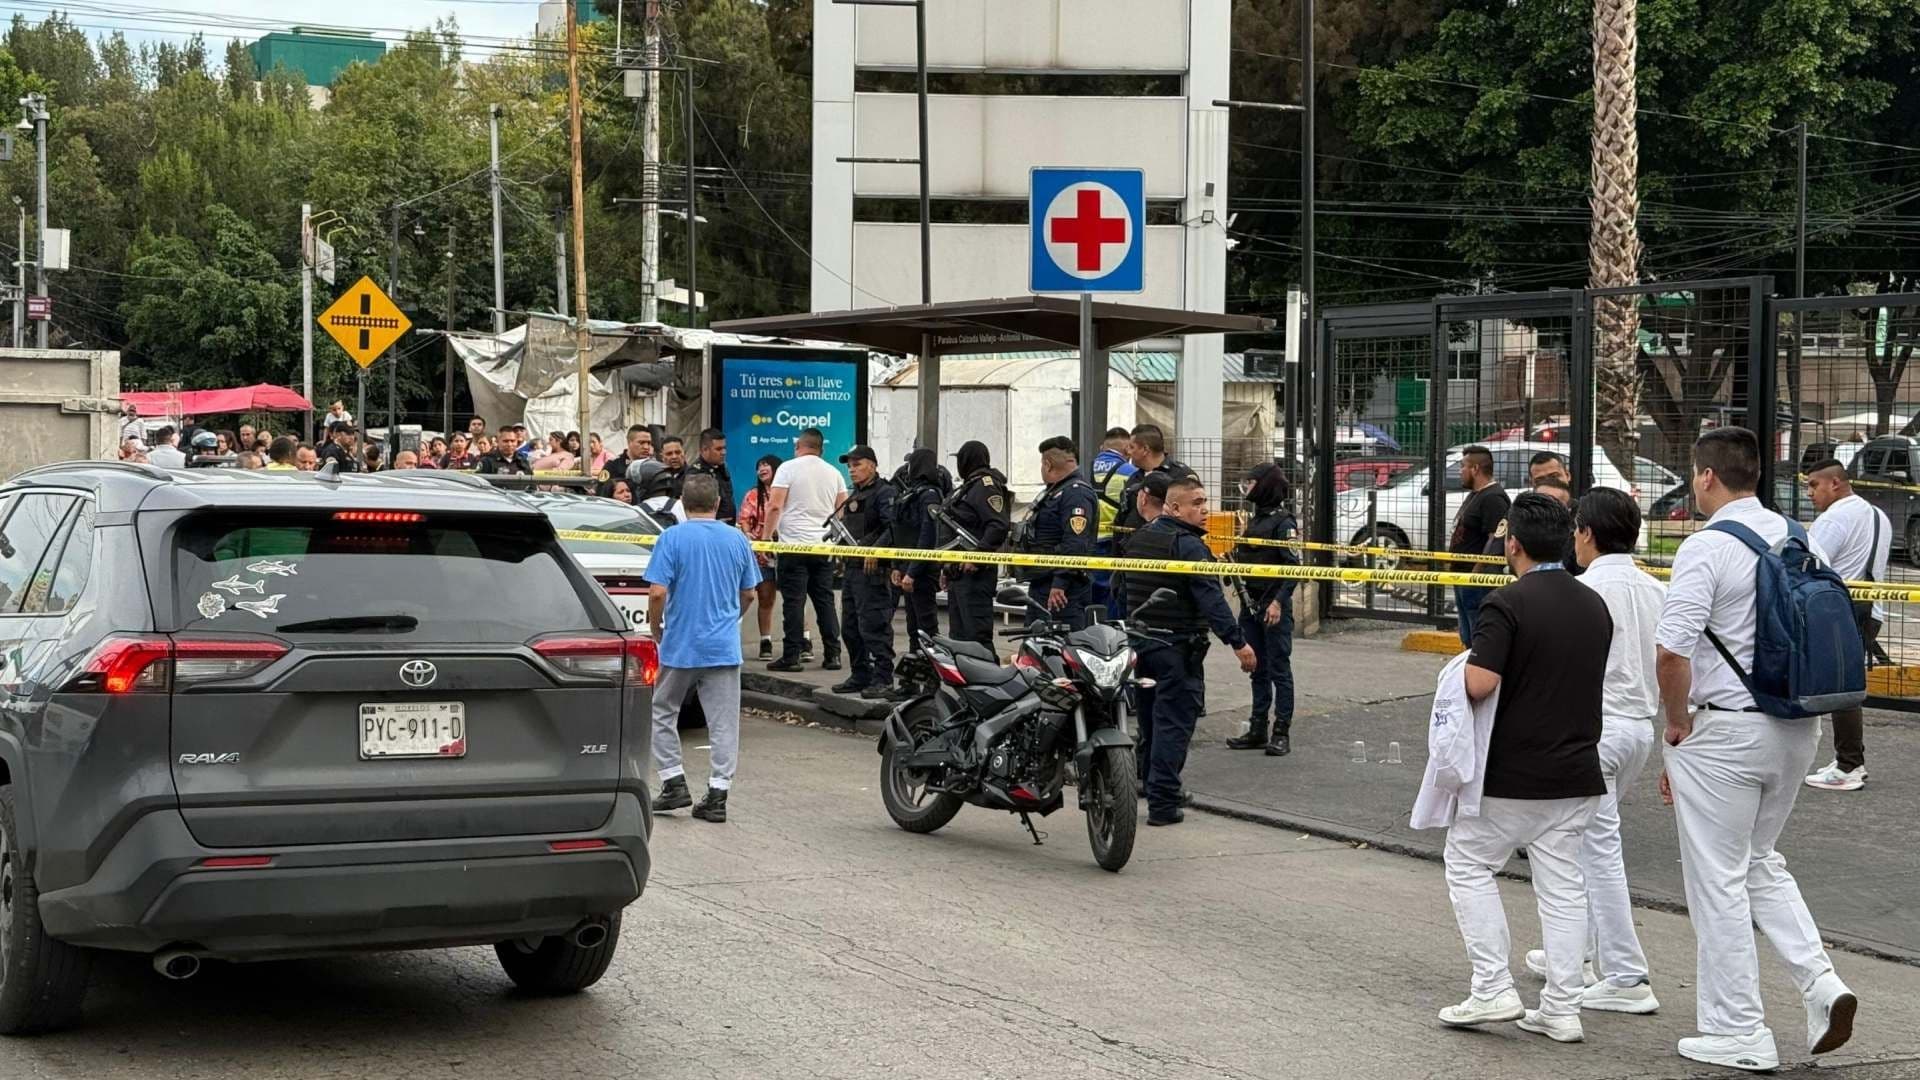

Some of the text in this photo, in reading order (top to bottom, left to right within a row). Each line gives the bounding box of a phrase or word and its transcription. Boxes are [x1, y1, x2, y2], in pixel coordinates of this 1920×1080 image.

[740, 373, 843, 388] Tú eres la llave
[730, 388, 851, 401] a un nuevo comienzo
[776, 410, 831, 430] Coppel
[1850, 588, 1910, 601] PRECAU
[364, 716, 461, 742] PYC-911-D
[580, 743, 608, 754] XLE
[178, 751, 240, 765] RAV4
